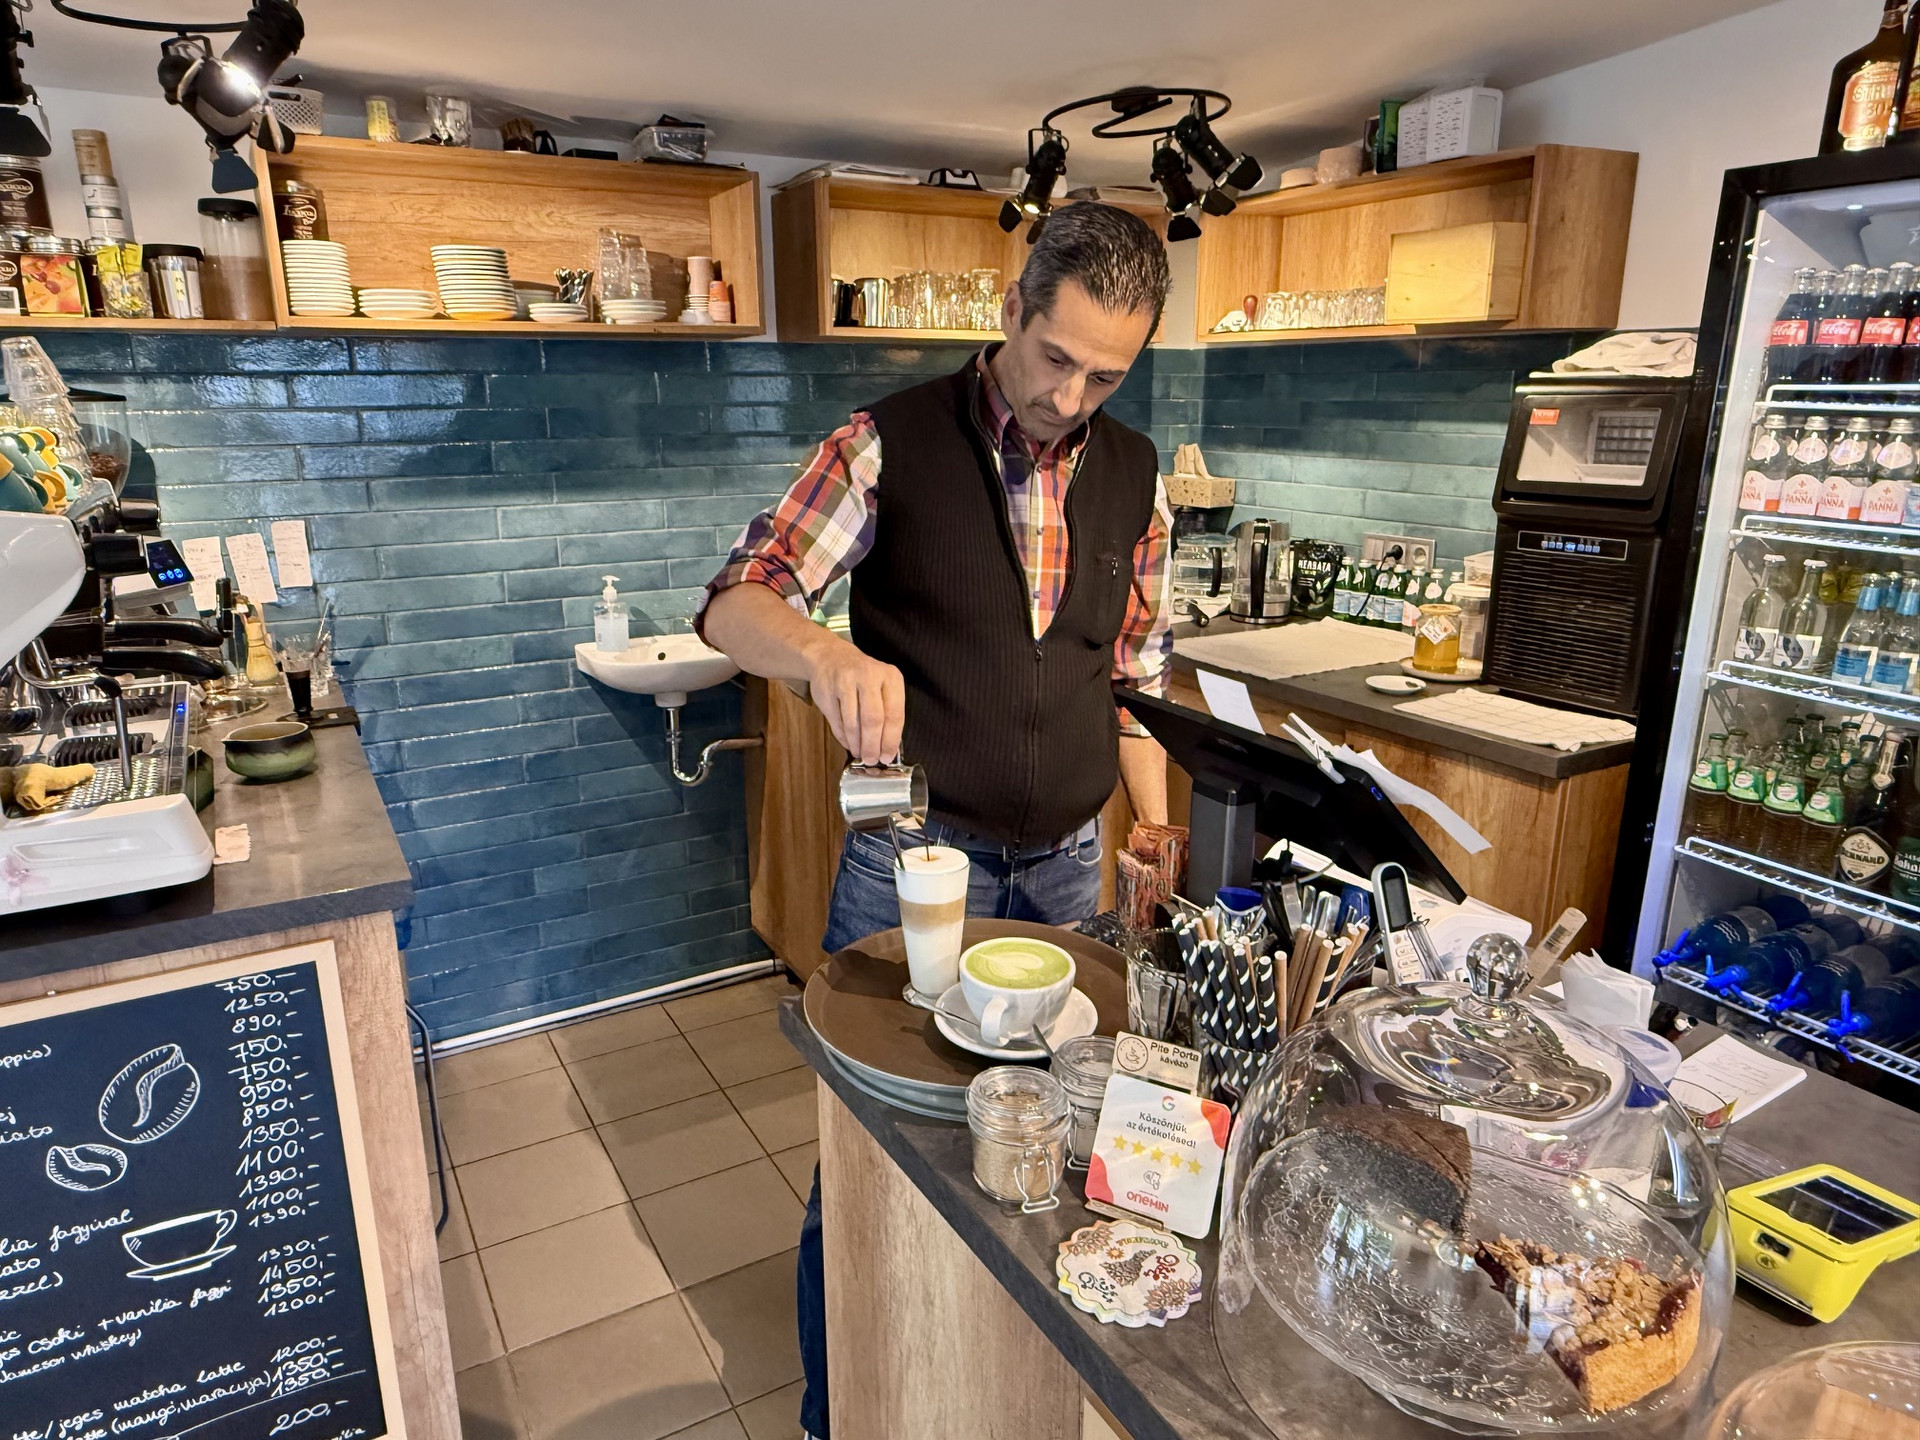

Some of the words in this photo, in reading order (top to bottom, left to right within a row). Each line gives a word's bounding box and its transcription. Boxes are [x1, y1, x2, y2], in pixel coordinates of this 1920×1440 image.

[1172, 1047, 1199, 1062] Porta
[1126, 1120, 1136, 1130] az
[1138, 1122, 1197, 1149] értékelésed!
[1139, 1112, 1188, 1134] Köszönjük
[113, 1382, 188, 1412] matcha
[196, 1361, 246, 1385] latte
